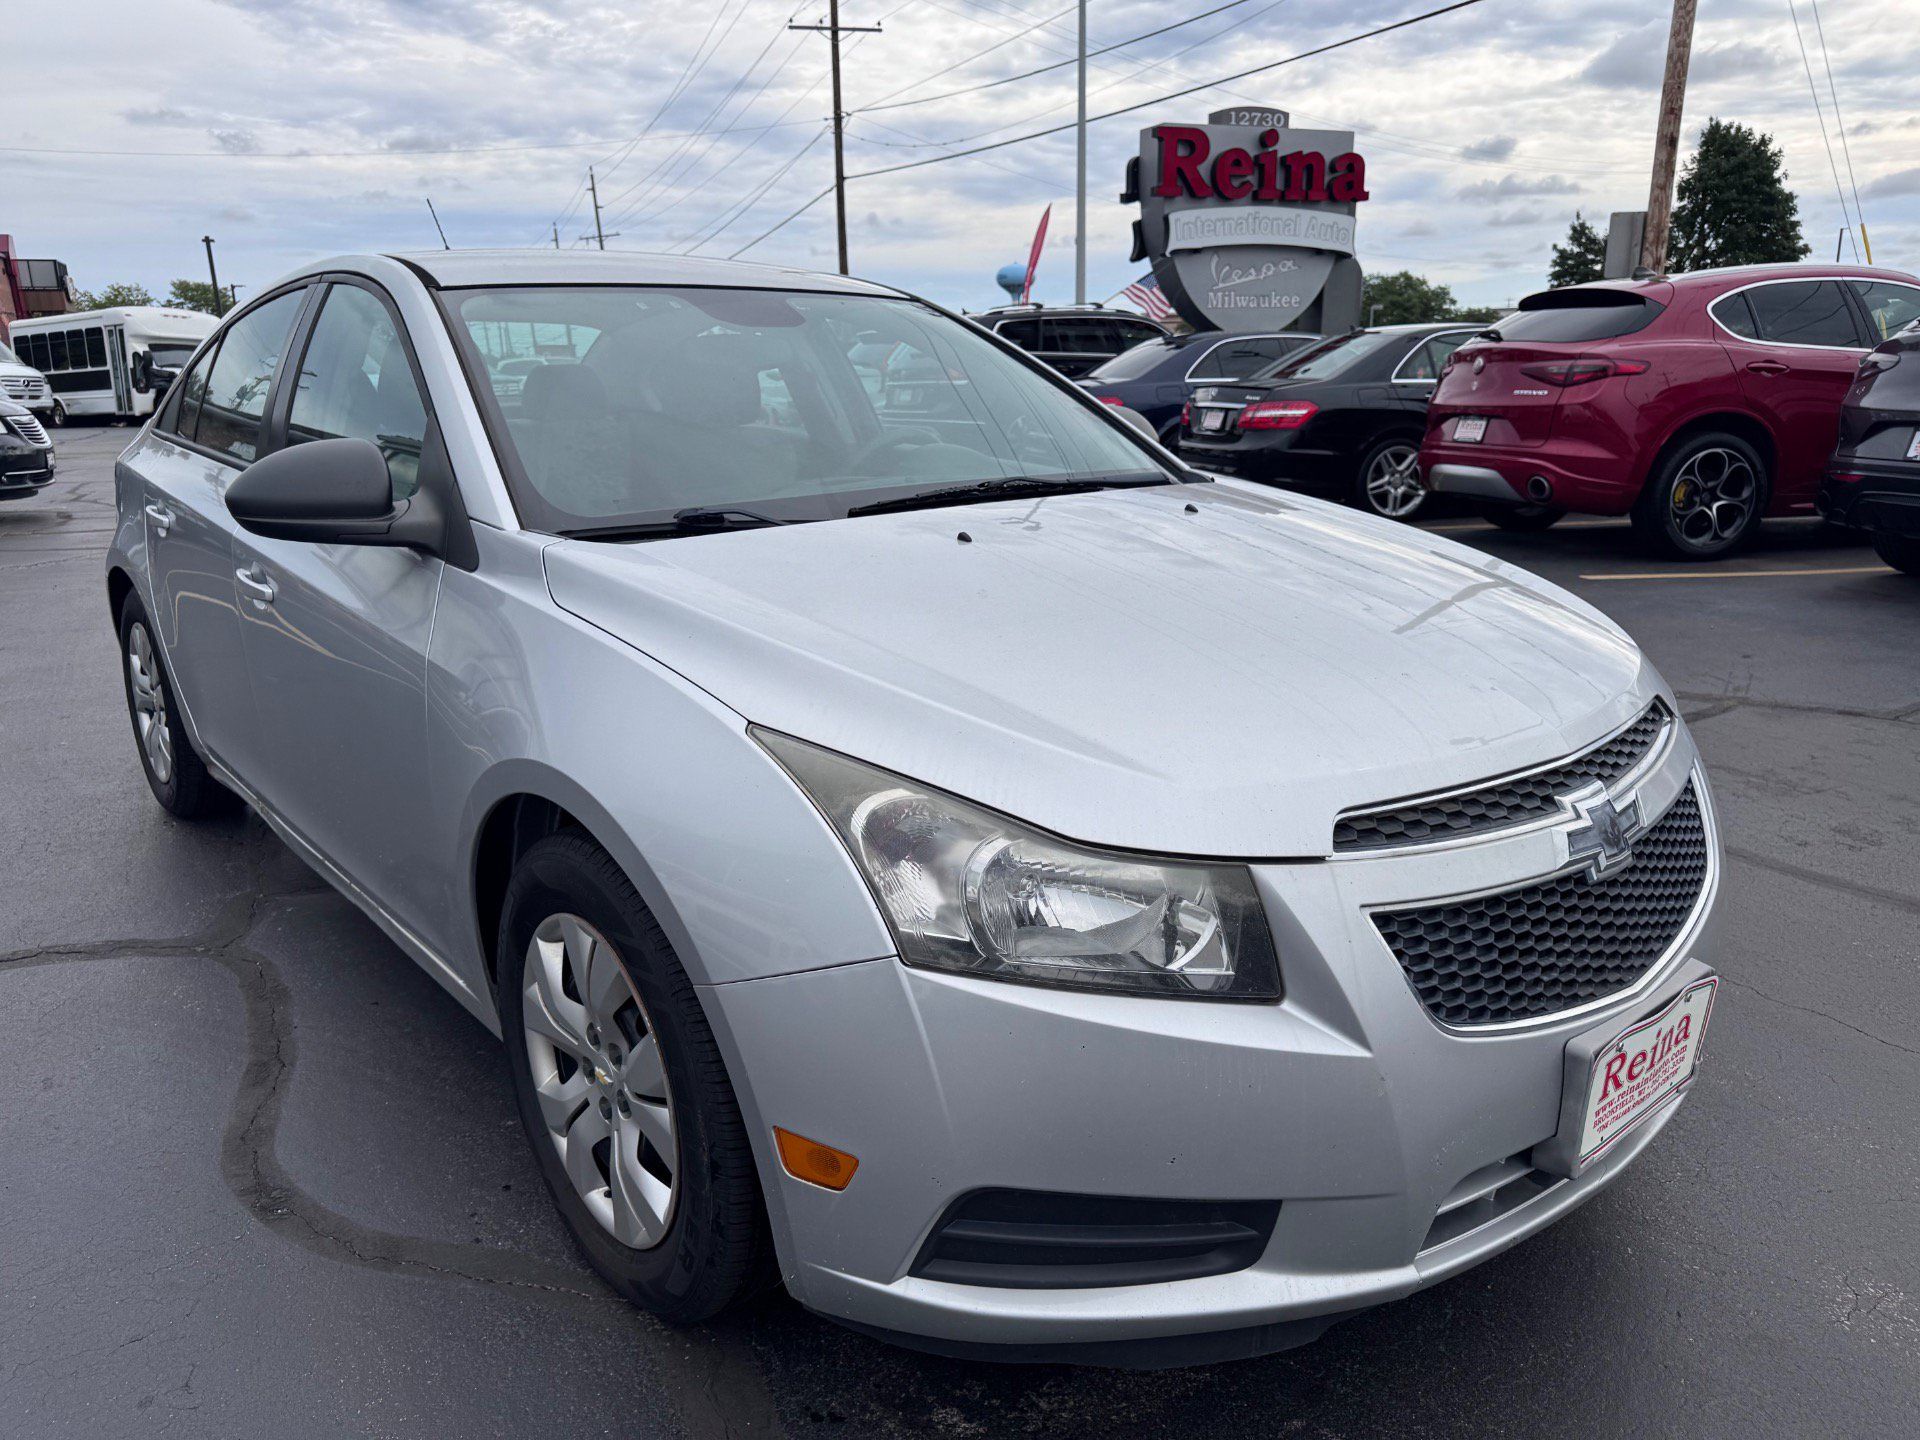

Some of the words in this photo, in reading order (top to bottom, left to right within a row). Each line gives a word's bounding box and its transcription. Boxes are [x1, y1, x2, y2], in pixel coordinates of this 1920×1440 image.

[1229, 111, 1285, 127] 12730
[1152, 126, 1369, 201] Reina
[1174, 212, 1300, 241] International
[1305, 216, 1350, 245] Auto
[1210, 253, 1299, 290] Vespa
[1207, 292, 1300, 308] Milwaukee
[1597, 1013, 1691, 1105] Reina
